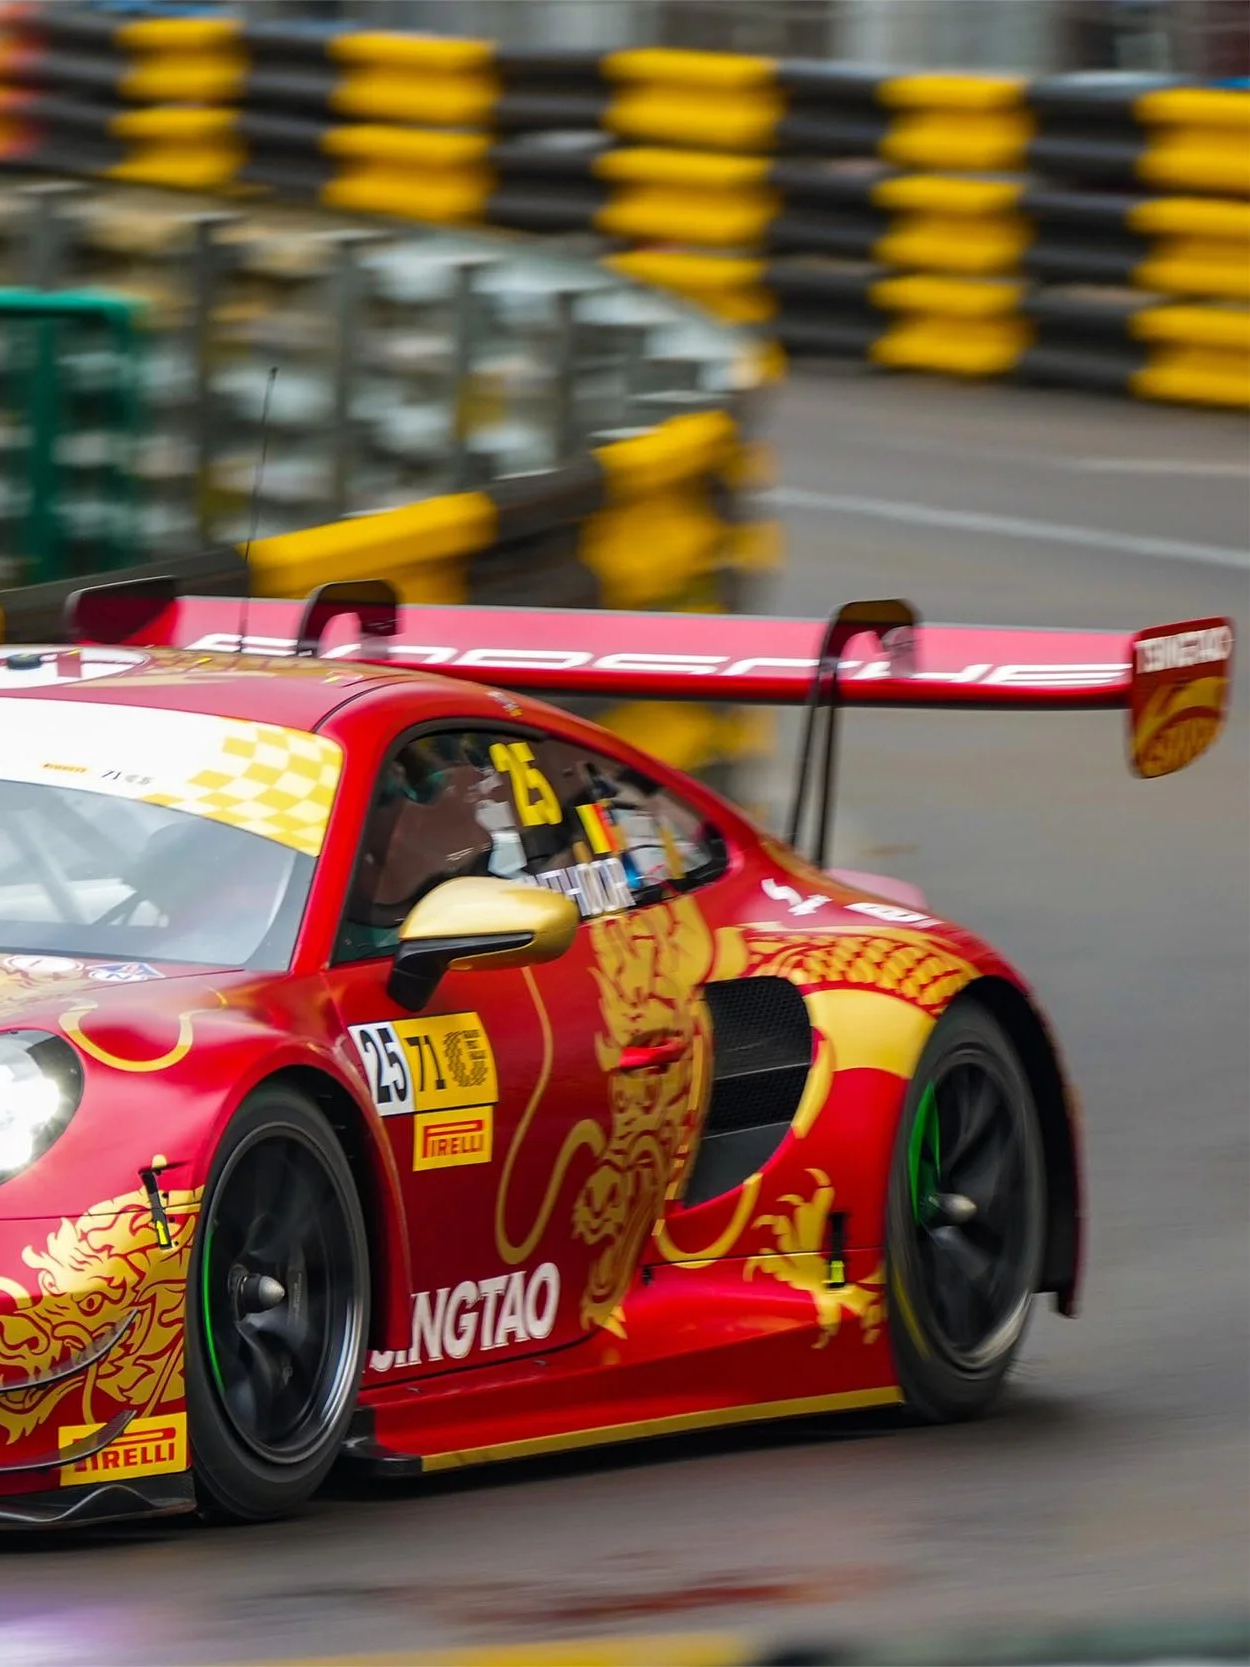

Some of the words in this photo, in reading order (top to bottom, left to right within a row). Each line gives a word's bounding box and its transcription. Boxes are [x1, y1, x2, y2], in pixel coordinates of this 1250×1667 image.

[489, 742, 563, 826] 25
[359, 1027, 408, 1105] 25
[404, 1035, 447, 1092] 71
[422, 1119, 484, 1159] PIRELLI
[368, 1262, 561, 1372] NGTAO
[71, 1427, 176, 1472] PIRELLI
